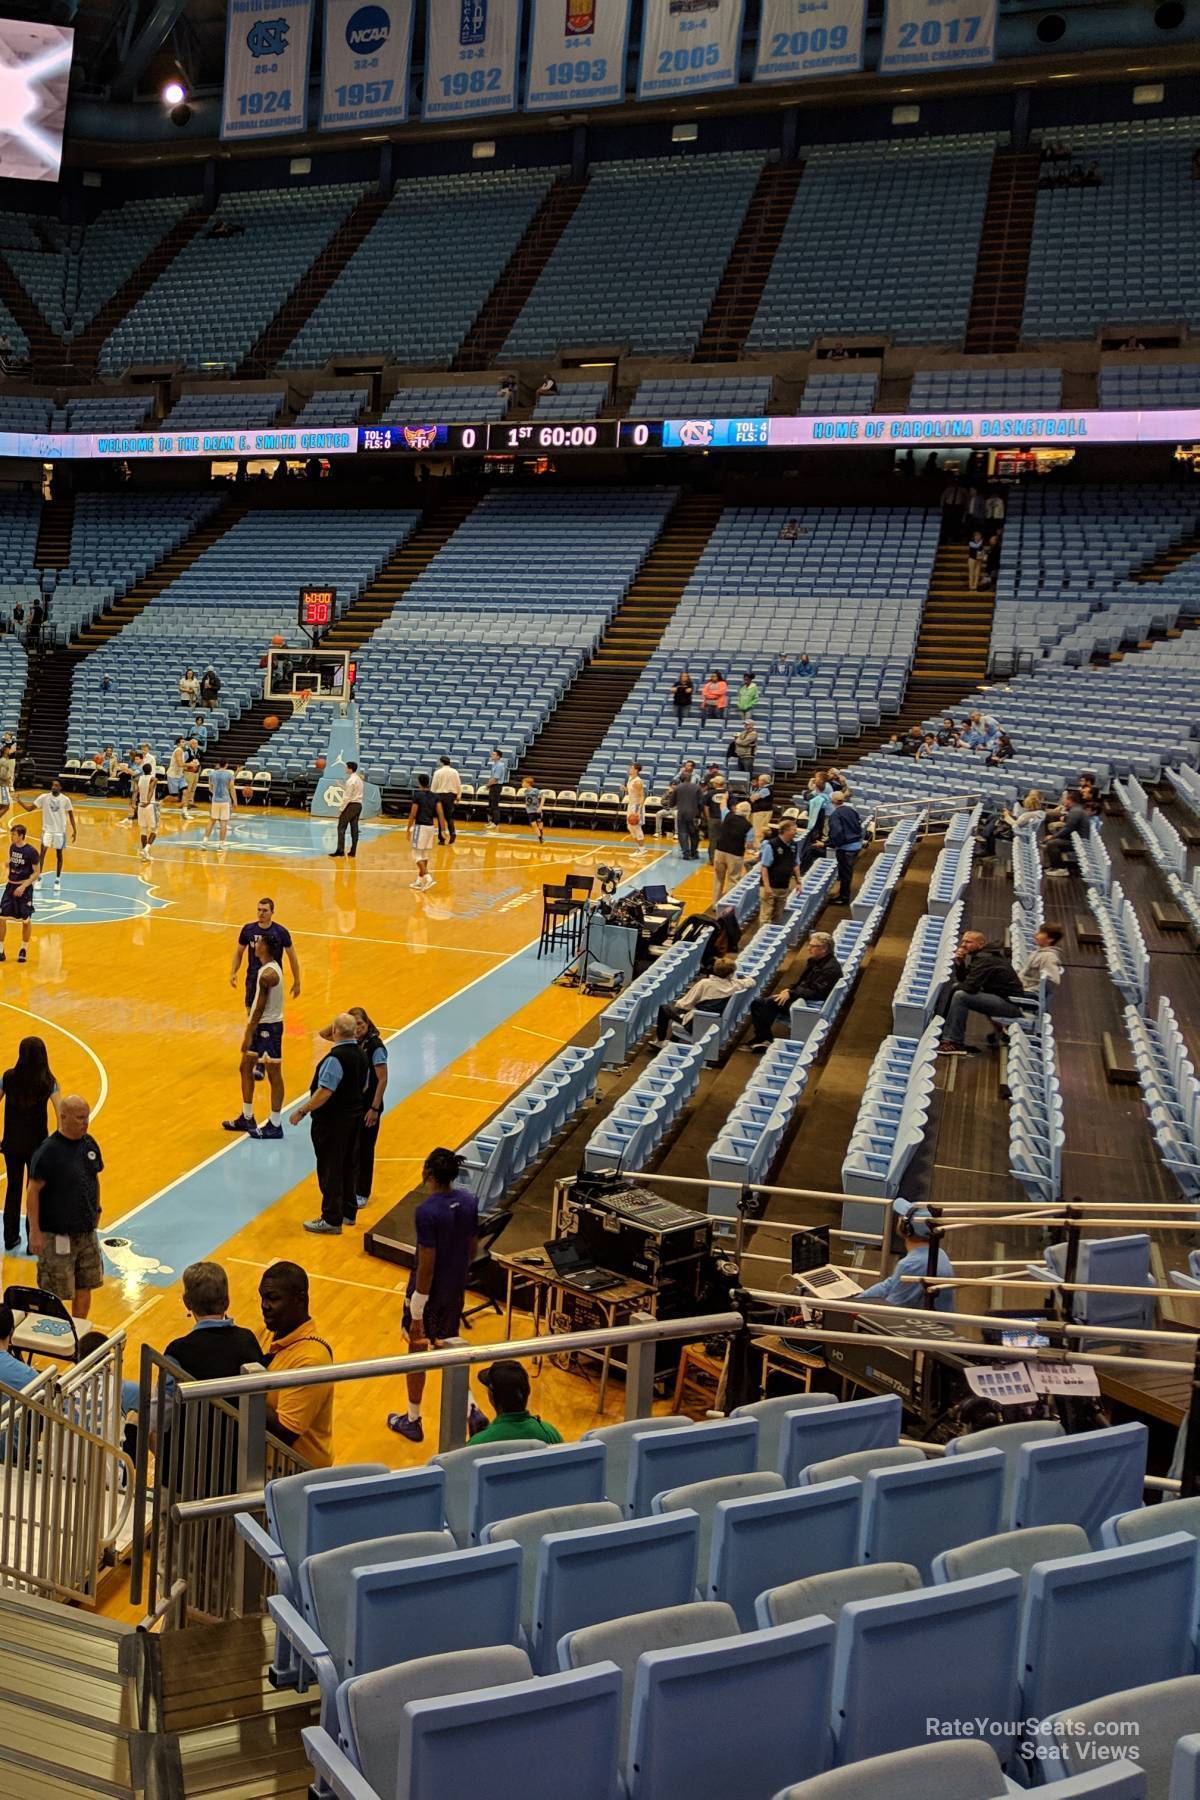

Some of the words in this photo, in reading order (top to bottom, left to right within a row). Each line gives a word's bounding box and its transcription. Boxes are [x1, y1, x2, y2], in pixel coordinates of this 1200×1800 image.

[350, 27, 389, 44] NCAA
[771, 25, 849, 57] 2009
[898, 16, 981, 48] 2017
[657, 43, 720, 73] 2005
[440, 68, 502, 97] 1982
[545, 59, 607, 86] 1993
[237, 89, 292, 116] 1924
[335, 80, 394, 107] 1957
[365, 430, 384, 440] TOL:
[385, 430, 391, 440] 4
[539, 426, 597, 446] 60:00
[634, 424, 649, 446] 0
[736, 423, 758, 432] TOL:
[759, 422, 767, 432] 4
[736, 432, 757, 442] FLS:
[759, 432, 767, 442] 0
[813, 421, 858, 438] HOME
[864, 421, 884, 438] OF
[891, 419, 972, 437] CAROLINA
[979, 418, 1087, 436] BASKETBALL
[99, 437, 154, 452] WELCOME
[159, 437, 173, 451] TO
[177, 437, 200, 451] THE
[204, 435, 235, 451] DEAN
[239, 435, 250, 450] E.
[255, 434, 297, 449] SMITH
[301, 433, 349, 448] CENTER
[365, 440, 383, 449] FLS:
[384, 440, 391, 449] 0
[462, 428, 476, 448] 0
[306, 604, 328, 622] 30
